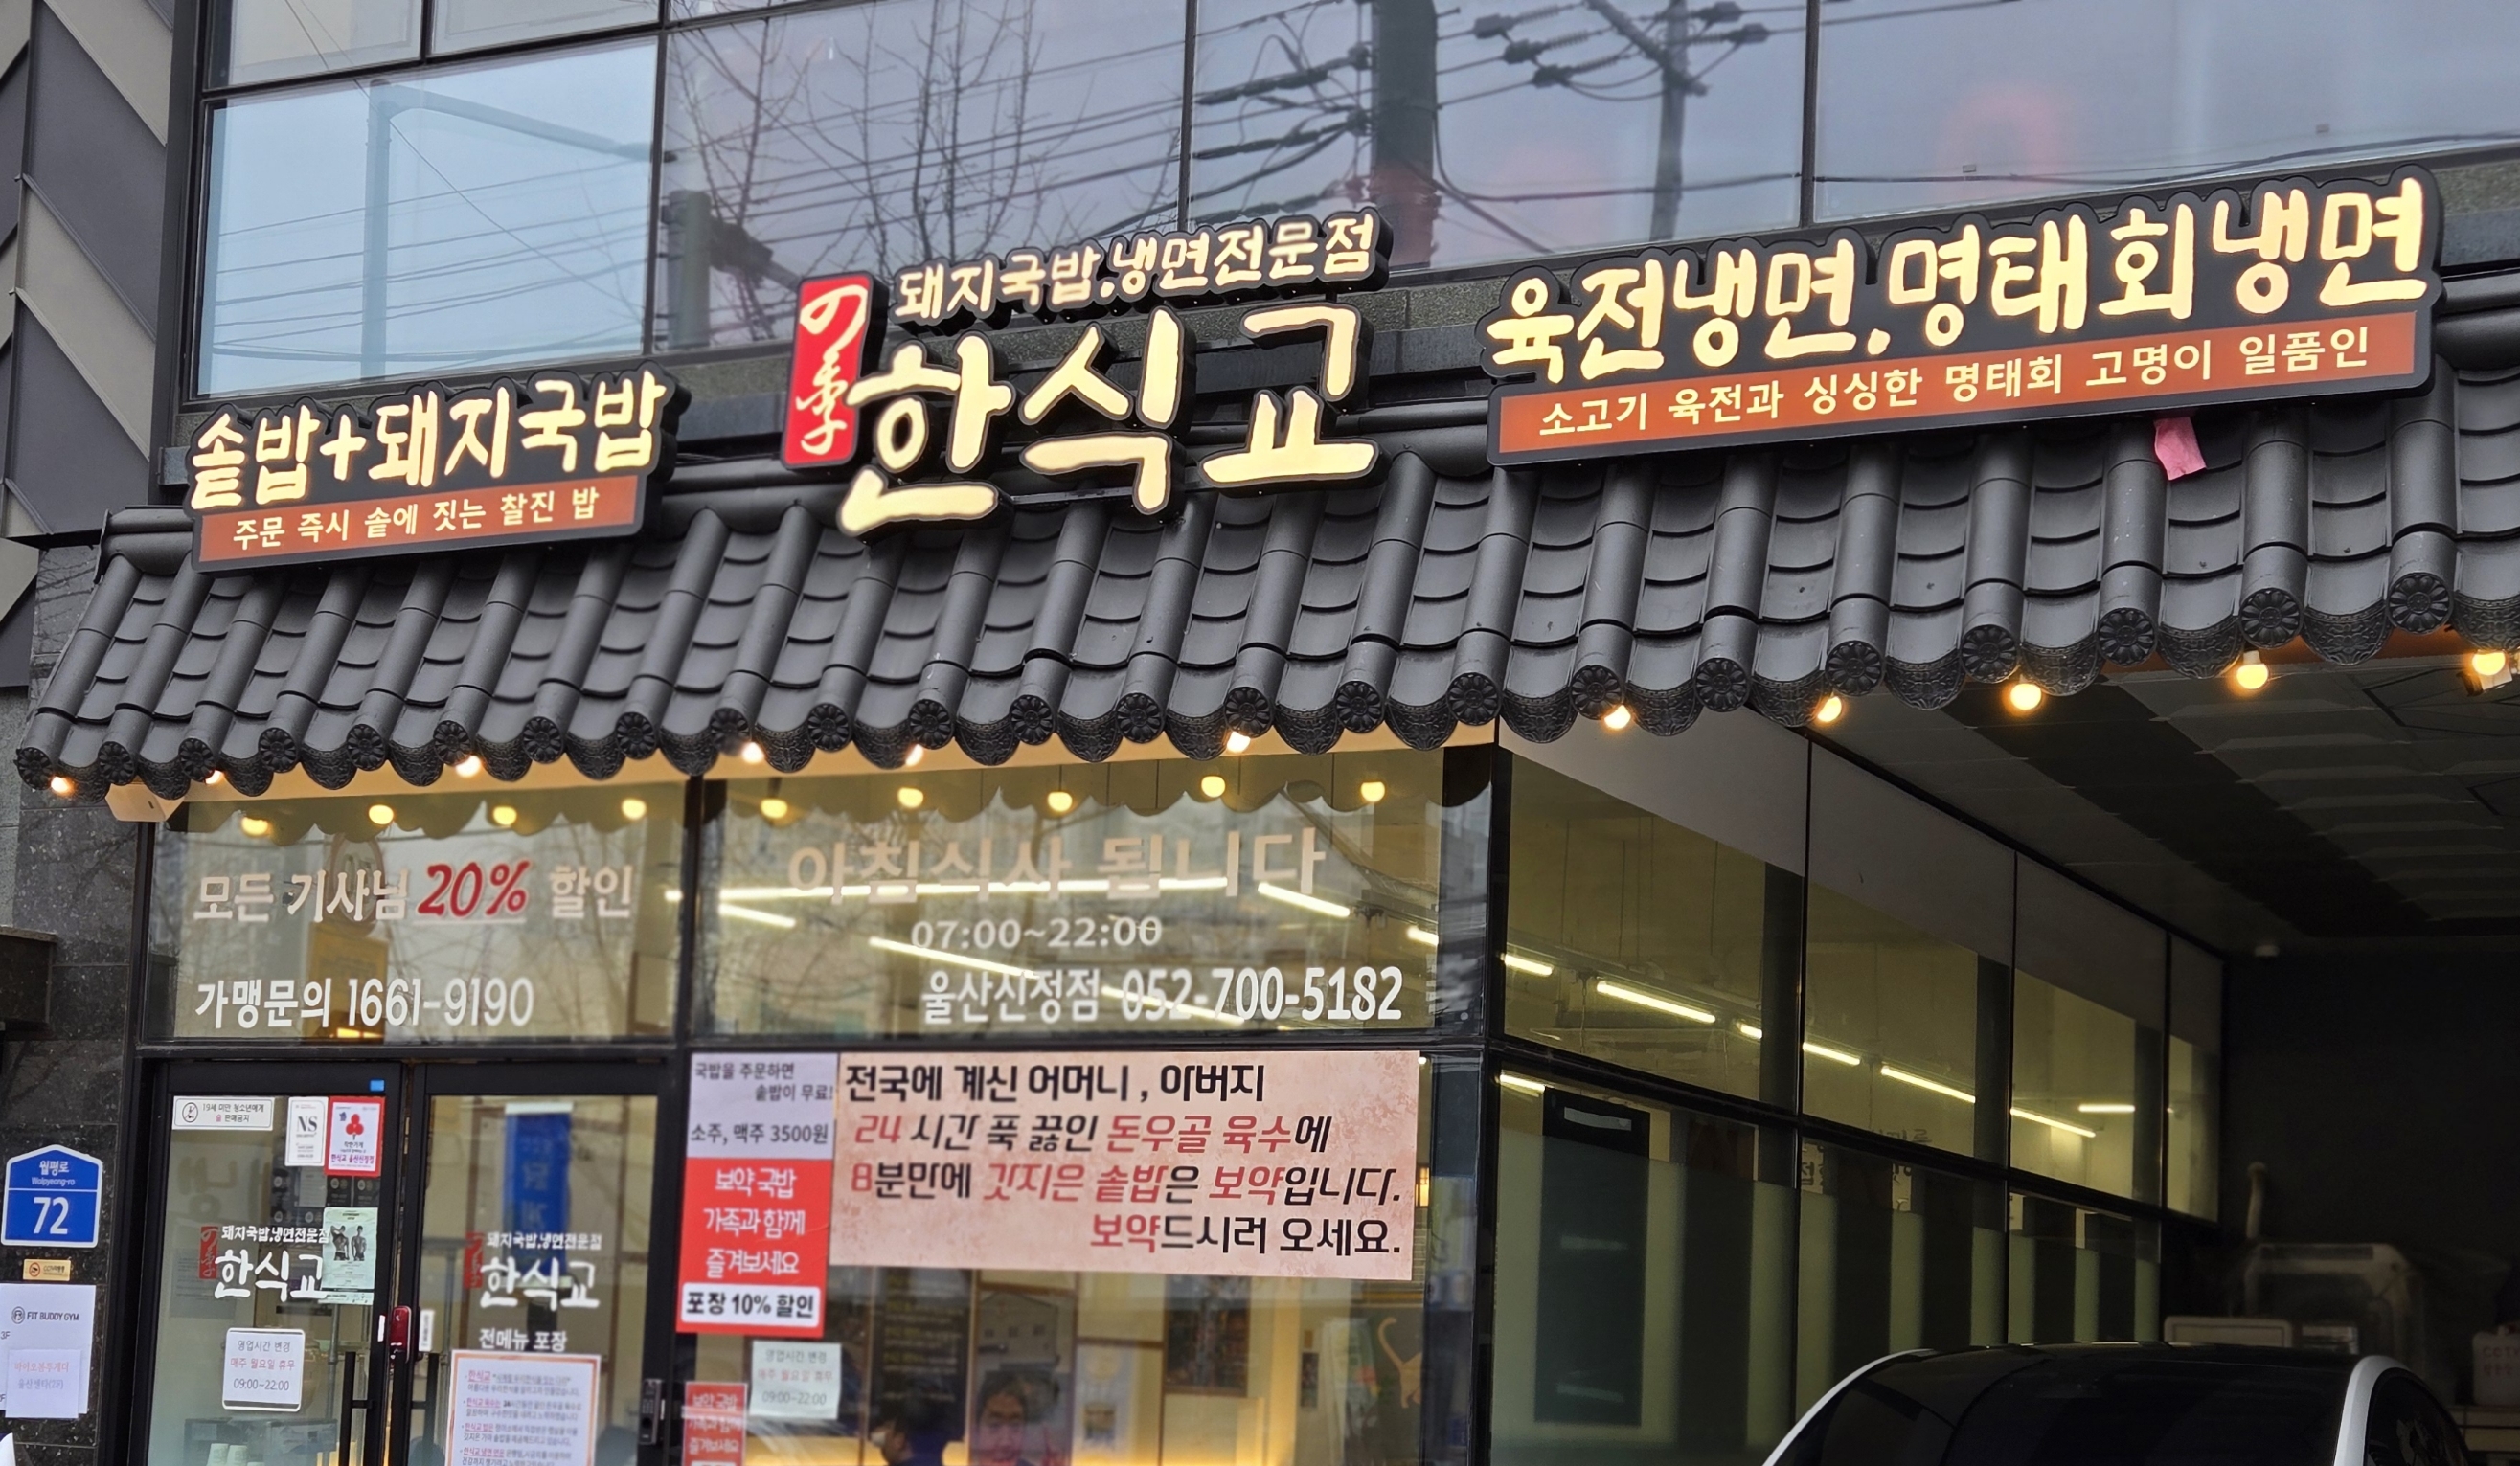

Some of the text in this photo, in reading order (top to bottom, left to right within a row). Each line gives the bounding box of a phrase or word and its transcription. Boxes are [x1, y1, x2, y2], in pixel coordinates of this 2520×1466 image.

[1539, 327, 2369, 436] 소고기 육전과 싱싱한 명태회 고명이 일품인
[841, 304, 1379, 533] 한식교
[233, 486, 600, 551] 주문 즉시 솥에 짓는 찰진 밥
[788, 827, 1327, 905] 아침식사 됩니다
[193, 861, 633, 922] 모든 기사님 20% 할인
[911, 916, 1163, 949] 07:00~22:00
[195, 977, 534, 1029] 가맹문의 1661-9190
[921, 966, 1402, 1025] 울산신정점 052-700-5182
[695, 1063, 794, 1080] 국밥을 주문하면
[846, 1065, 943, 1102] 전국에
[954, 1065, 1018, 1102] 계신
[1029, 1065, 1128, 1102] 어머니
[1161, 1065, 1264, 1102] 아버지
[202, 1103, 216, 1112] 19세
[218, 1103, 231, 1112] 미만
[801, 1084, 833, 1101] 무료!
[691, 1123, 829, 1145] 소주, 맥주 3500원
[854, 1115, 1332, 1154] 24 시간 푹 끓인 돈우골 육수에
[31, 1177, 76, 1187] Wolpyeong-ro
[39, 1160, 70, 1176] 월평로
[715, 1167, 797, 1198] 보약 국밥
[851, 1162, 1400, 1206] 8분만에 갓지은 솥밥은 보약입니다.
[33, 1196, 69, 1235] 72
[703, 1207, 806, 1239] 가족과 함께
[1090, 1214, 1400, 1256] 보약드시러 오세요.
[214, 1249, 329, 1302] 한식교
[706, 1248, 799, 1278] 즐겨보세요
[480, 1256, 601, 1312] 한식교
[27, 1312, 79, 1321] FIT BUDDY GYM
[686, 1292, 814, 1319] 포장 10% 할인
[238, 1340, 290, 1353] 영업시간 변경
[479, 1327, 568, 1352] 전메뉴 포장
[230, 1358, 295, 1371] 매주 월요일 휴무
[234, 1378, 290, 1390] 09:00~22:00
